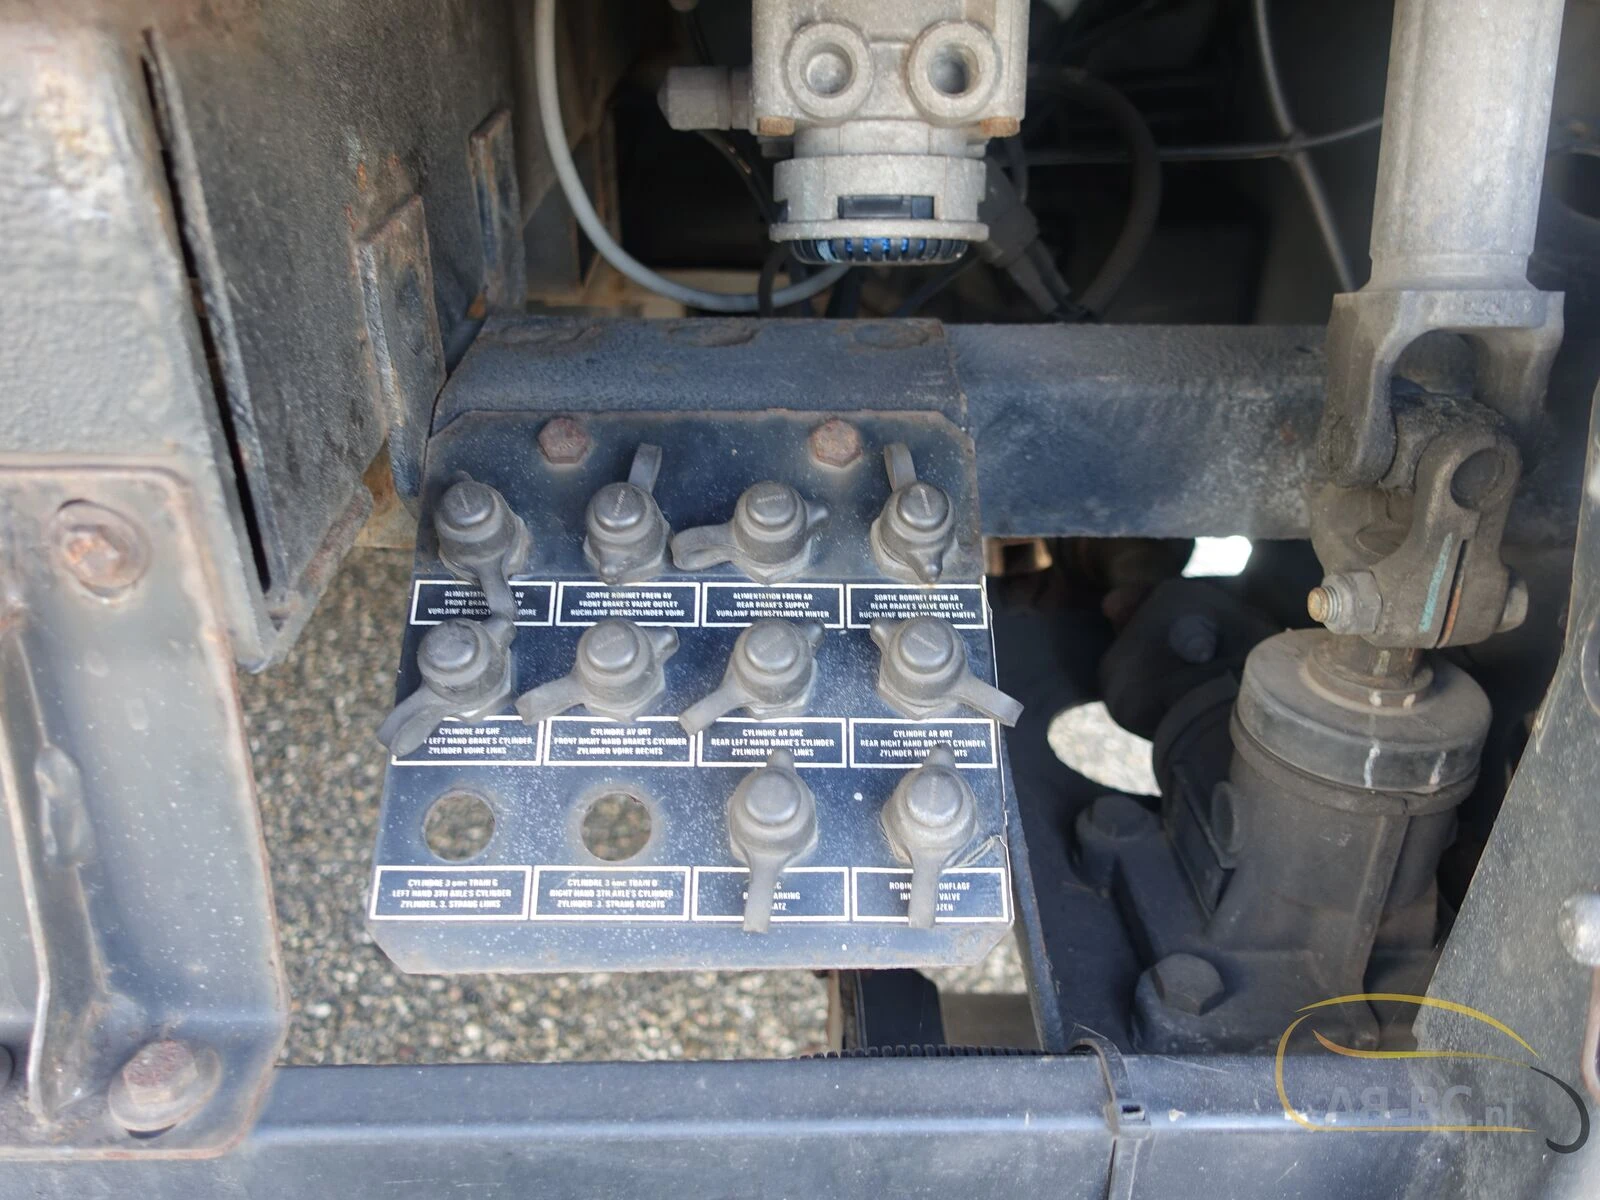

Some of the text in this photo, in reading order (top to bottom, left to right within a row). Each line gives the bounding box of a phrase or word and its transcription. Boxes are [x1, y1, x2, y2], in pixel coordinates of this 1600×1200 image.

[429, 737, 446, 745] LEFT
[448, 737, 467, 745] HAND
[499, 737, 533, 745] CYLINDER
[711, 738, 730, 746] REAR
[732, 738, 748, 746] LEFT
[750, 738, 769, 746] HAND
[801, 738, 835, 746] CYLINDER
[860, 739, 879, 747] REAR
[880, 739, 901, 747] RIGHT
[903, 739, 922, 747] HAND
[953, 739, 986, 747] CYLINDER
[392, 889, 410, 897] LEFT
[939, 893, 961, 901] VALVE
